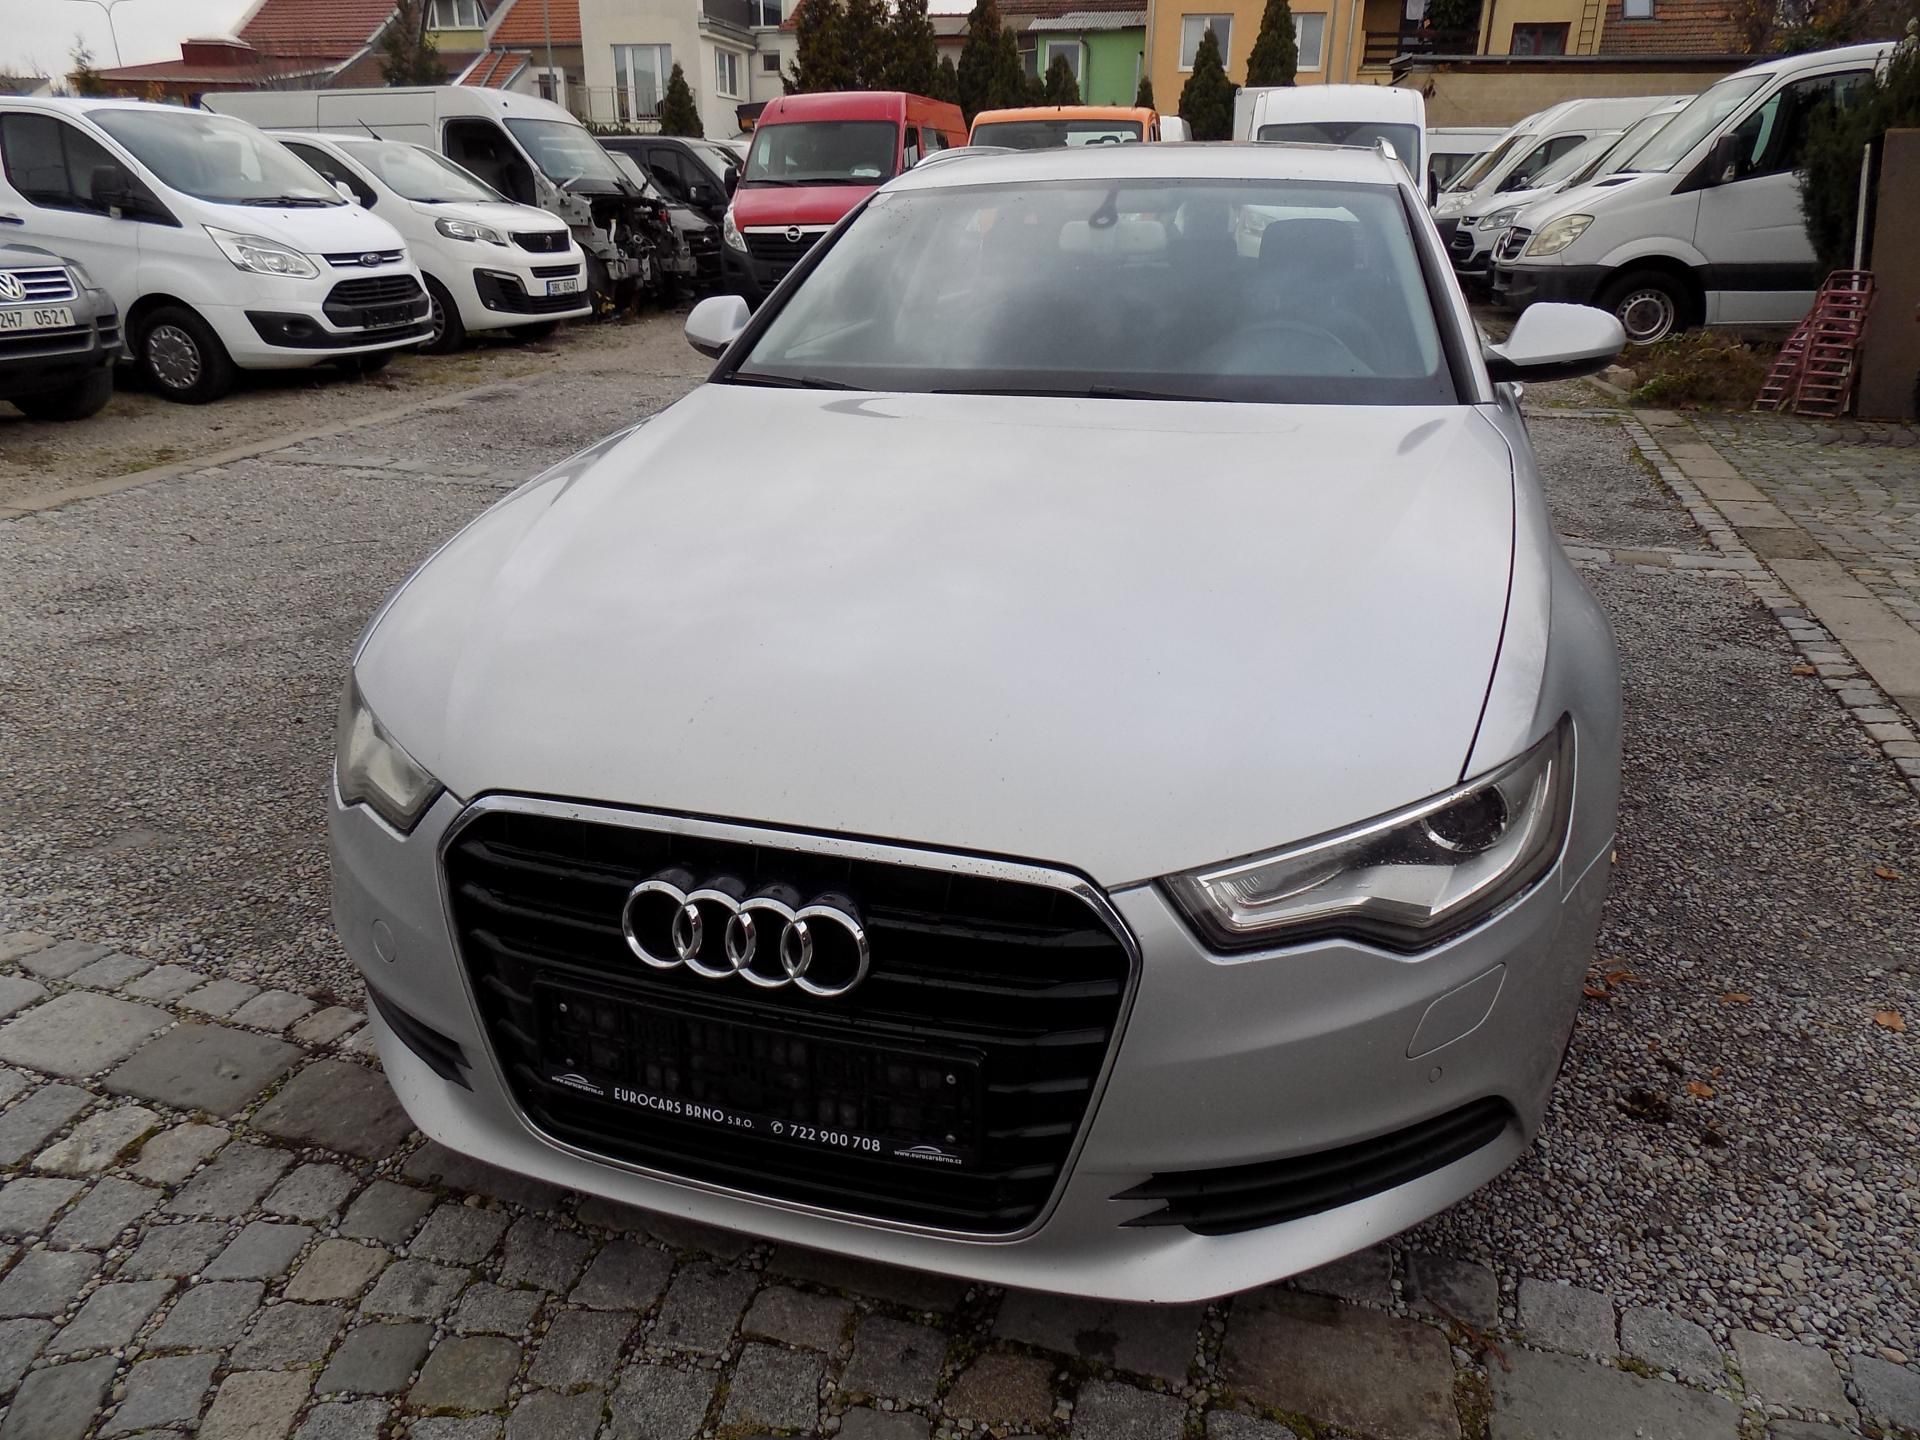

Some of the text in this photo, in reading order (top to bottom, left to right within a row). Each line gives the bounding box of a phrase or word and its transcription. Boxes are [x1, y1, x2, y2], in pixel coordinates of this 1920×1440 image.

[0, 309, 68, 329] 2H7 0521
[614, 1087, 881, 1152] EUROCARS BRNO S.R.O. 722 900 708
[893, 1149, 962, 1165] www.eurocarsbrno.cz
